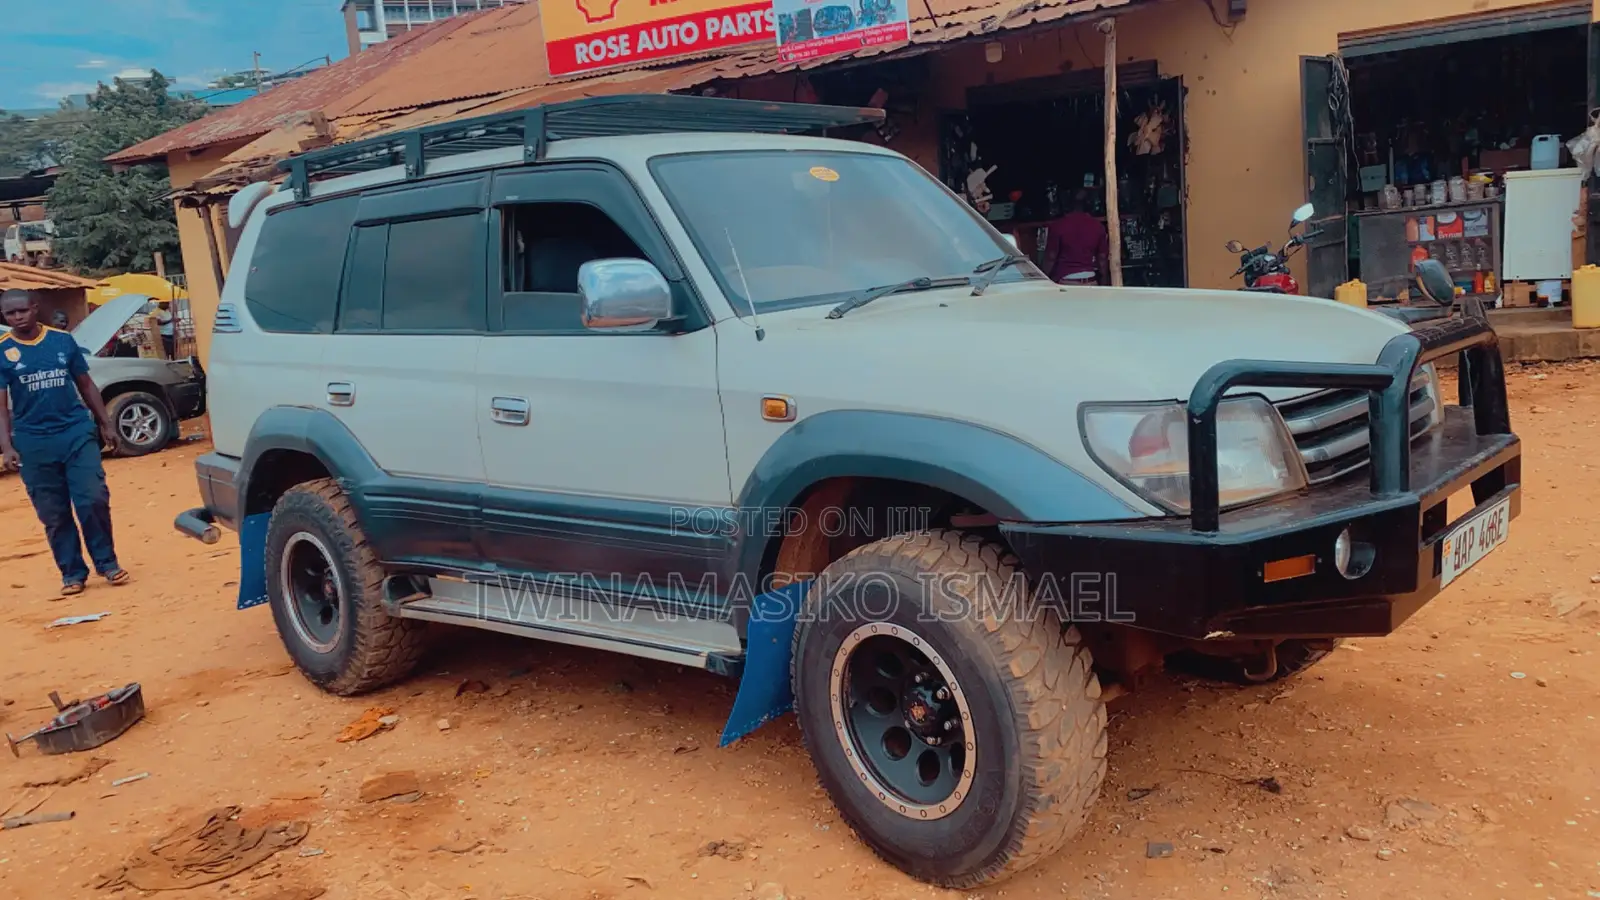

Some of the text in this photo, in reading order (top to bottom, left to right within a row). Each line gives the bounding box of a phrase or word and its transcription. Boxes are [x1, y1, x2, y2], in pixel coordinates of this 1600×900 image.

[574, 34, 631, 64] ROSE
[637, 21, 699, 53] AUTO
[705, 7, 777, 40] PARTS
